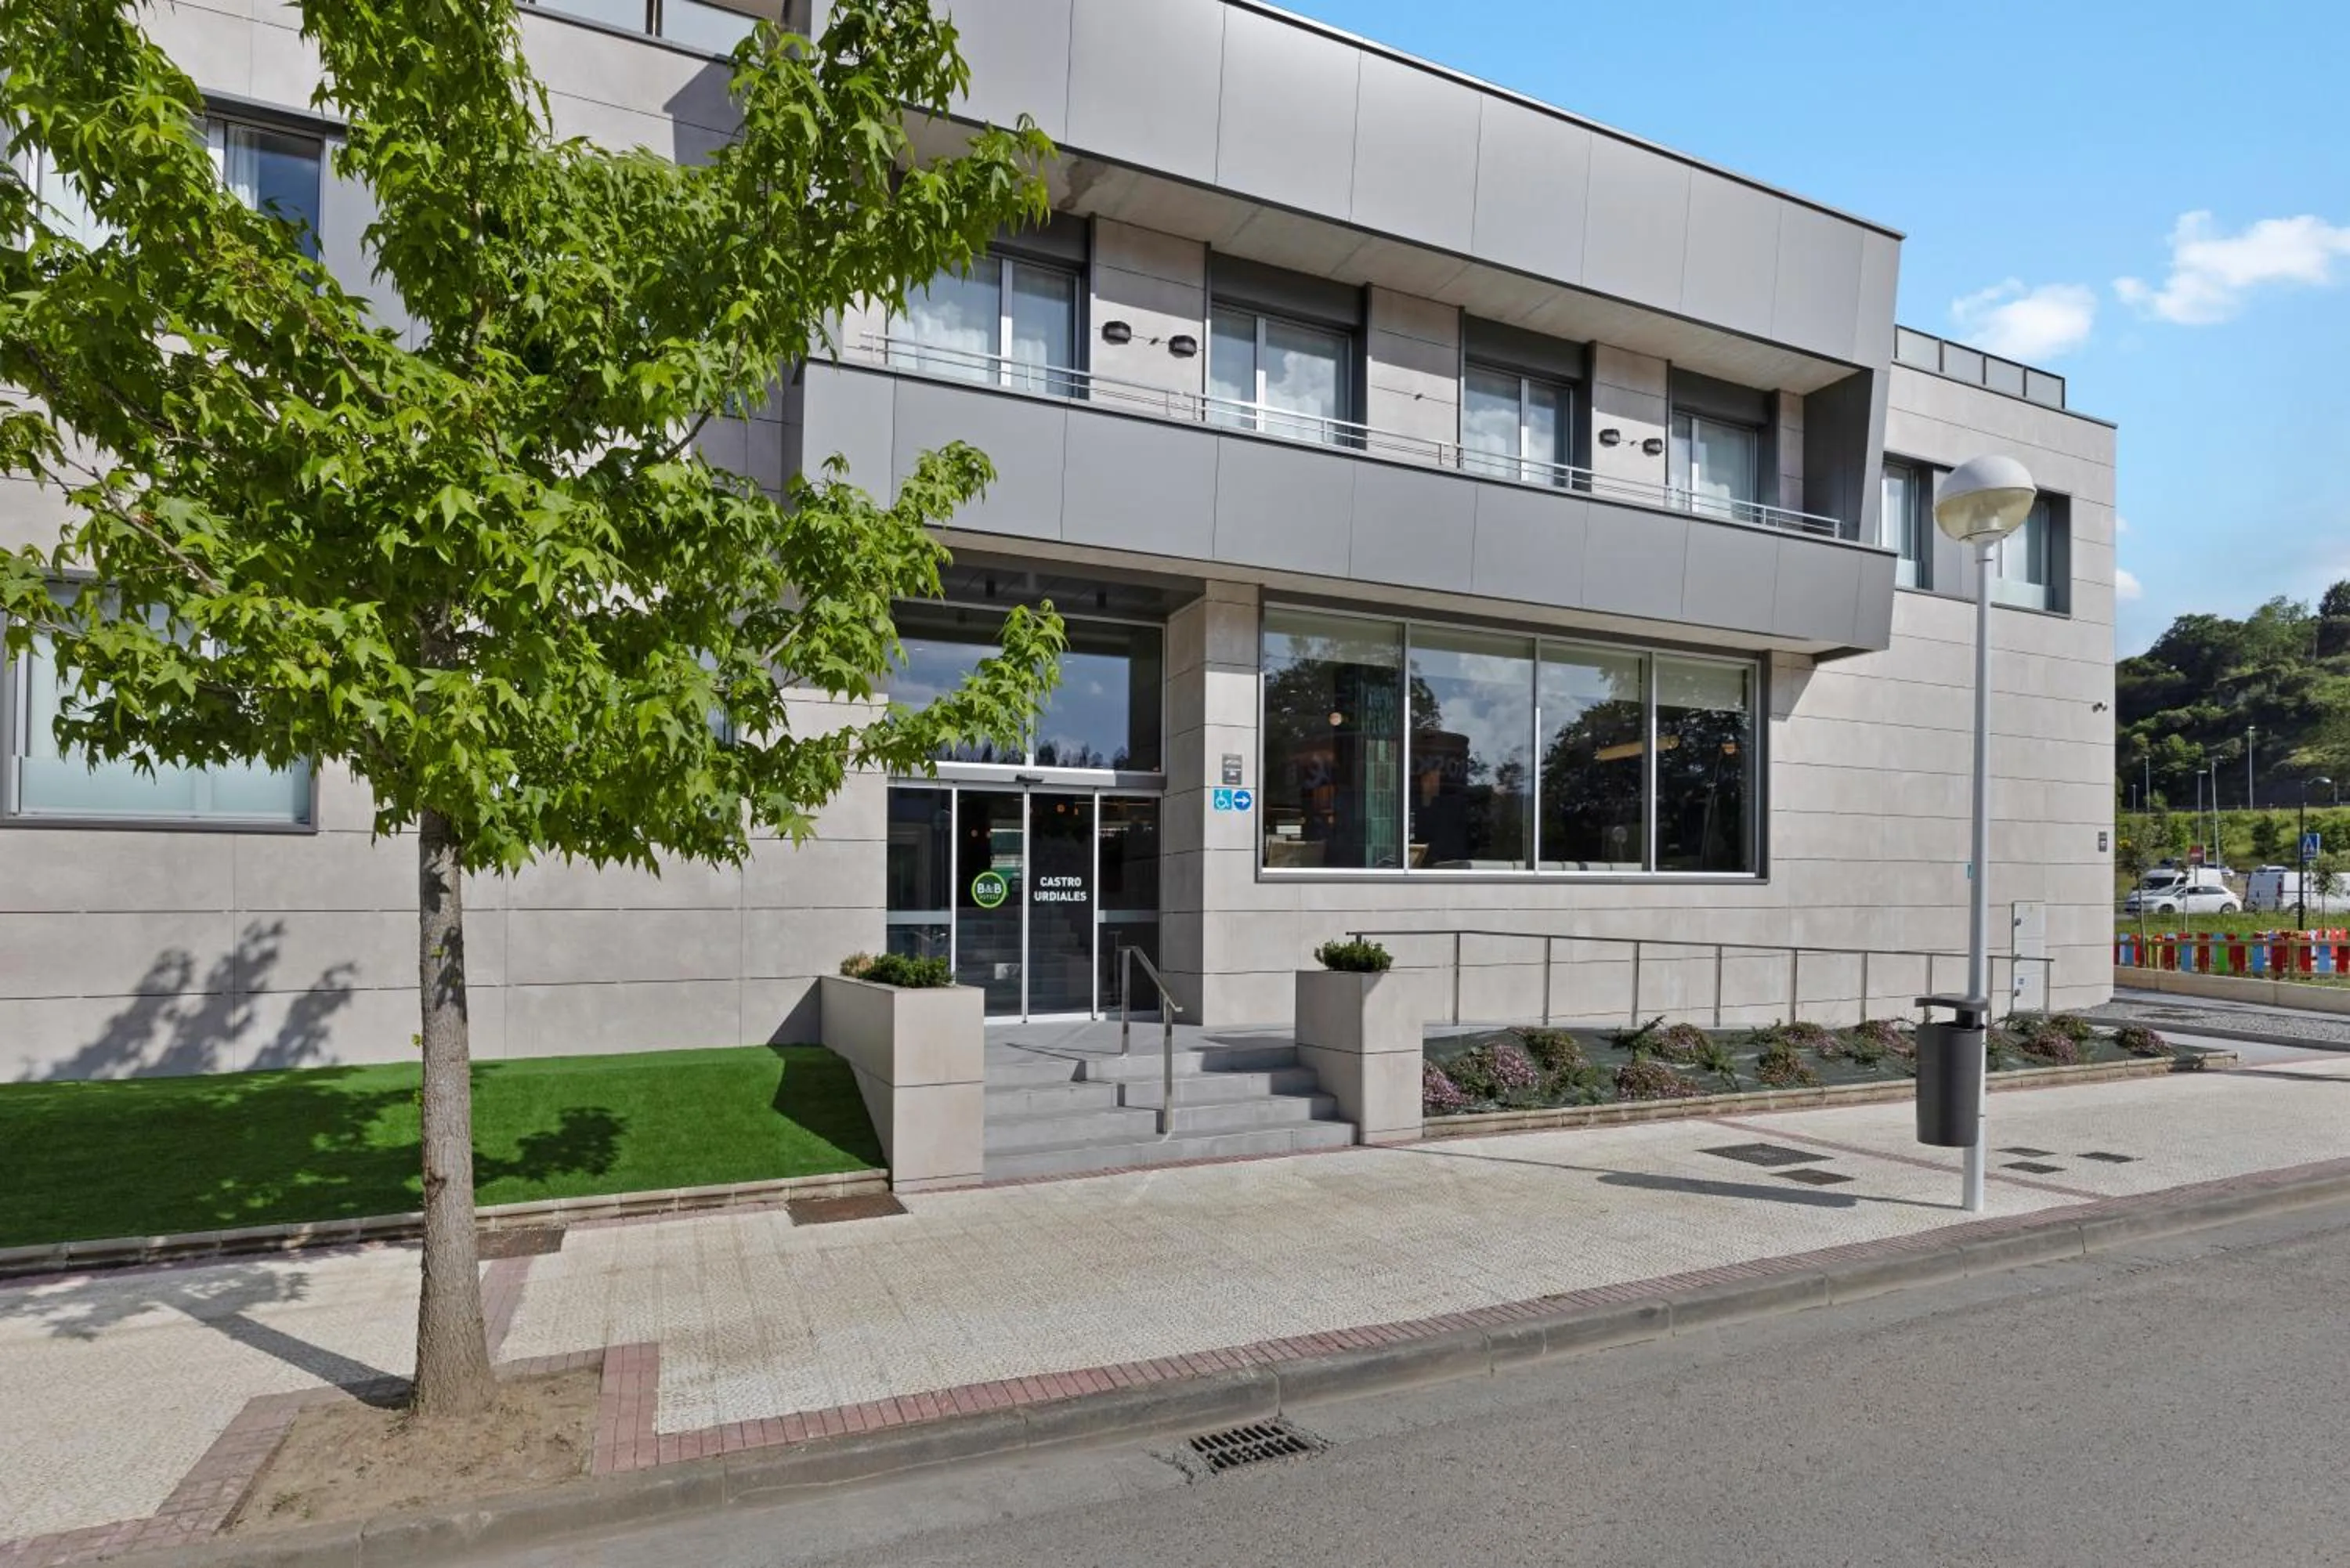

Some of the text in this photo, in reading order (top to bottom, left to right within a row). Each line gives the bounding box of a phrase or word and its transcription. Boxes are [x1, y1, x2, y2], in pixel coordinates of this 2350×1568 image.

[1039, 876, 1082, 887] CASTRO
[977, 883, 1002, 894] B&B
[1034, 891, 1087, 901] URDIALES
